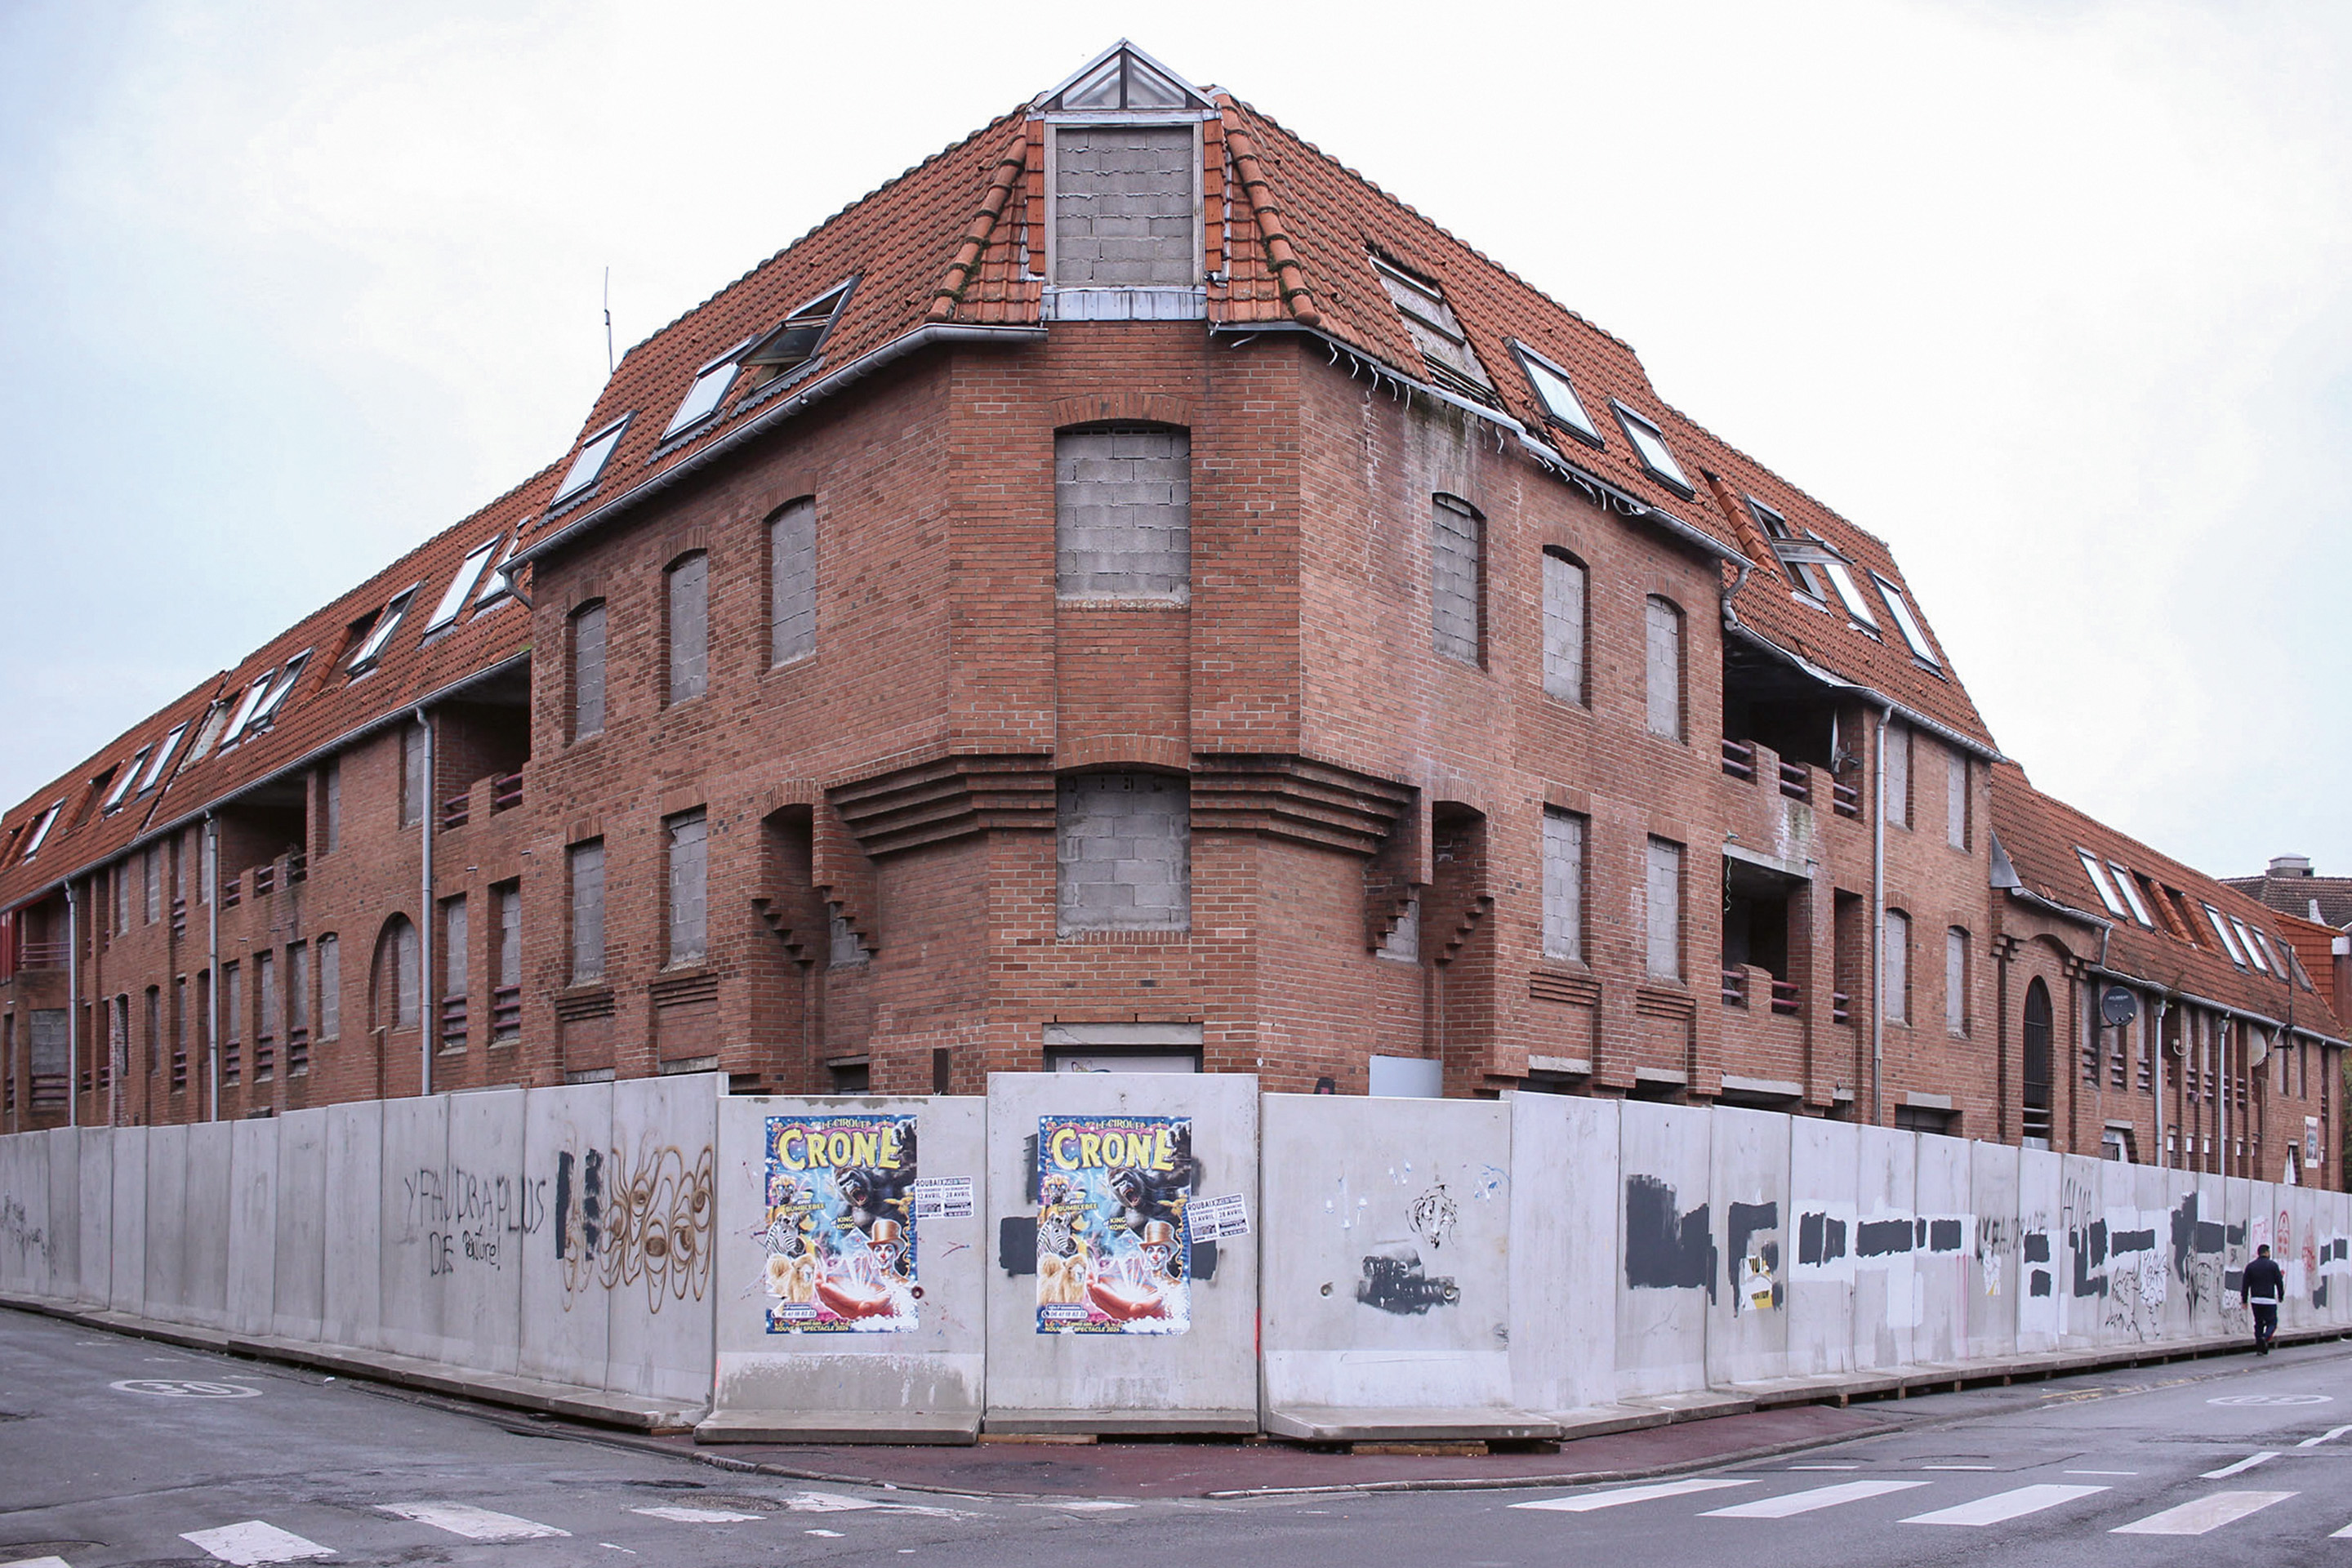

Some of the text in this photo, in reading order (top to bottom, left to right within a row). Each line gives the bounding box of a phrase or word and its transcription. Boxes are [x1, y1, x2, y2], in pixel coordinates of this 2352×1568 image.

[833, 1118, 867, 1130] CIRQUE
[1107, 1119, 1141, 1130] CIRQUE
[777, 1126, 901, 1171] CRONE
[1052, 1127, 1175, 1172] CRONE
[786, 1203, 825, 1213] BUMBLEBEE
[1058, 1203, 1098, 1212] BUMBLEBEE
[1187, 1200, 1216, 1210] ROUBAIX
[1198, 1214, 1214, 1222] AVRIL
